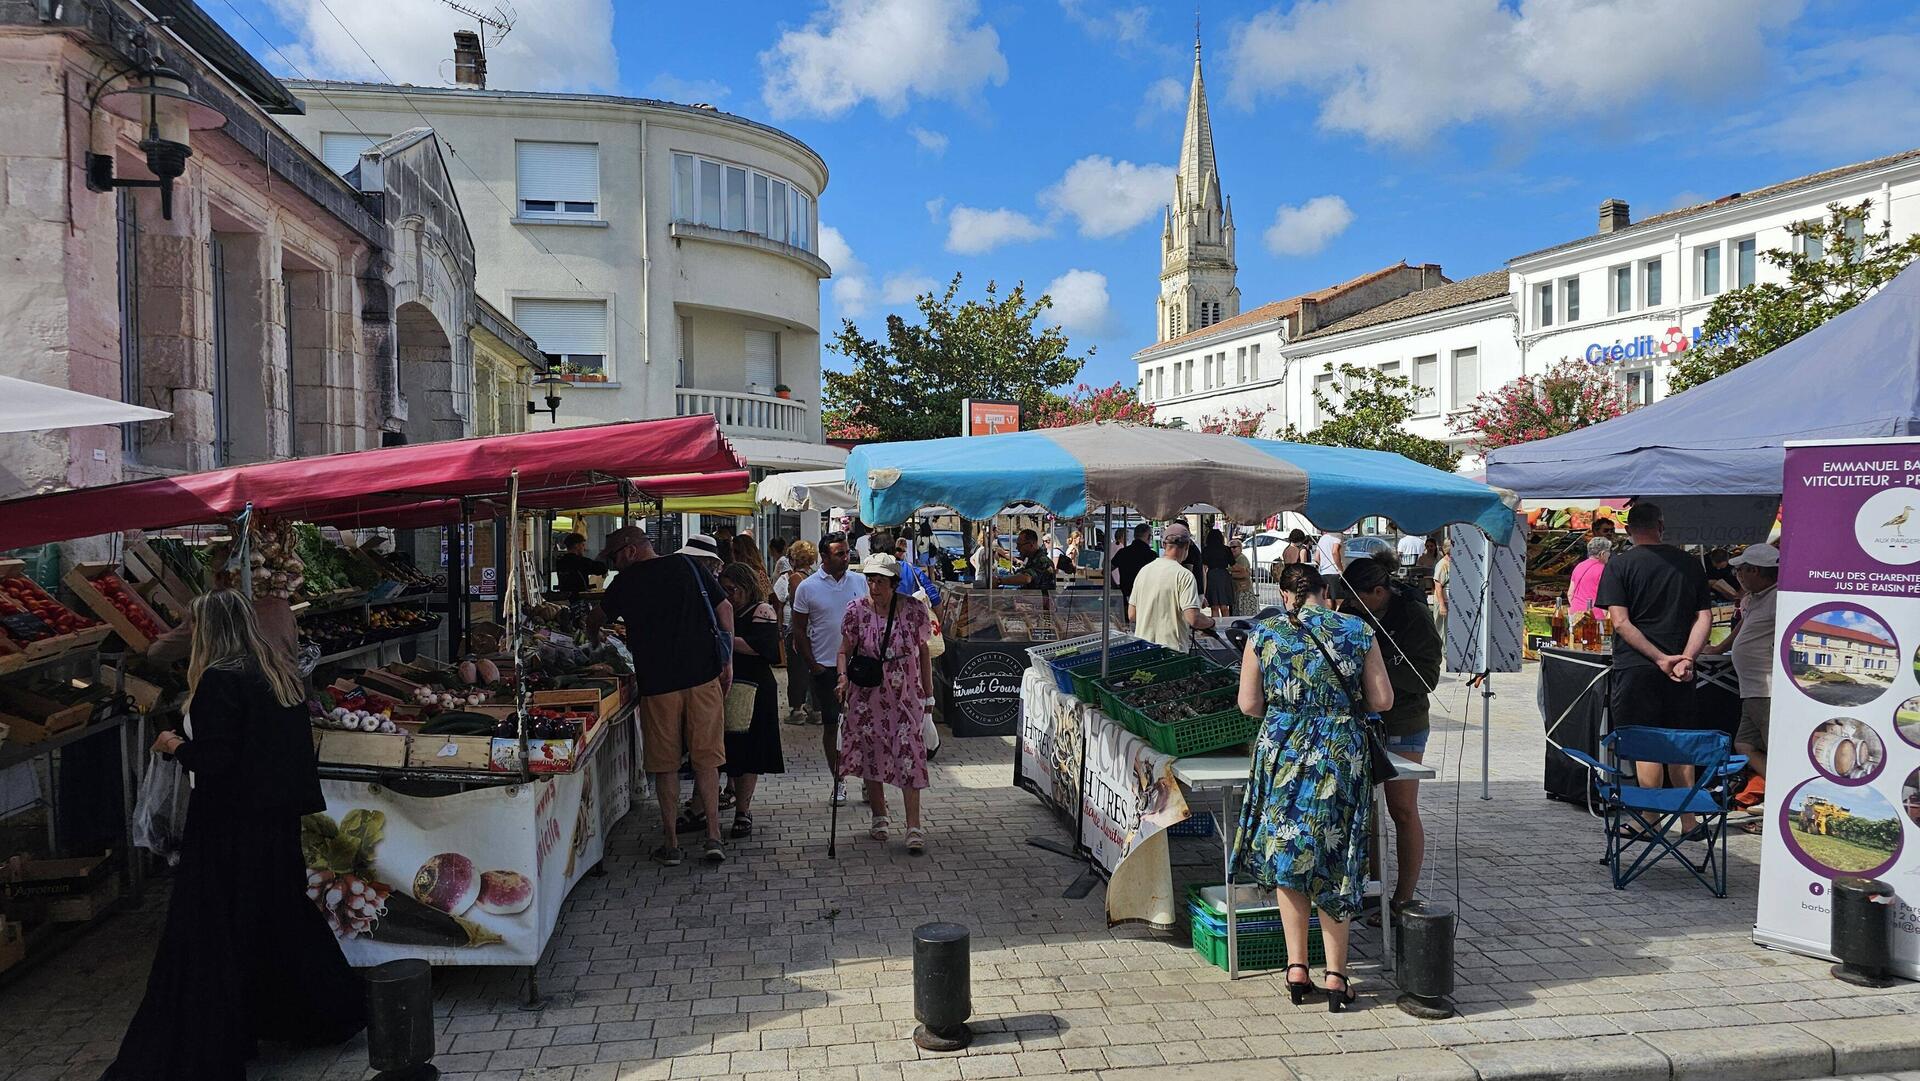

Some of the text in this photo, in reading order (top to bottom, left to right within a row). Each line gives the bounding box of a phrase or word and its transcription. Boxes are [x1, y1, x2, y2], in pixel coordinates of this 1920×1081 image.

[1586, 335, 1654, 365] Crédit
[1823, 460, 1920, 472] EMMANUEL BA
[1803, 475, 1889, 487] VITICULTEUR
[1906, 475, 1920, 486] PR
[1809, 571, 1844, 579] PINEAU
[1847, 572, 1865, 580] DES
[1835, 582, 1853, 590] JUS
[1856, 583, 1868, 591] DE
[1872, 584, 1904, 592] RAISIN
